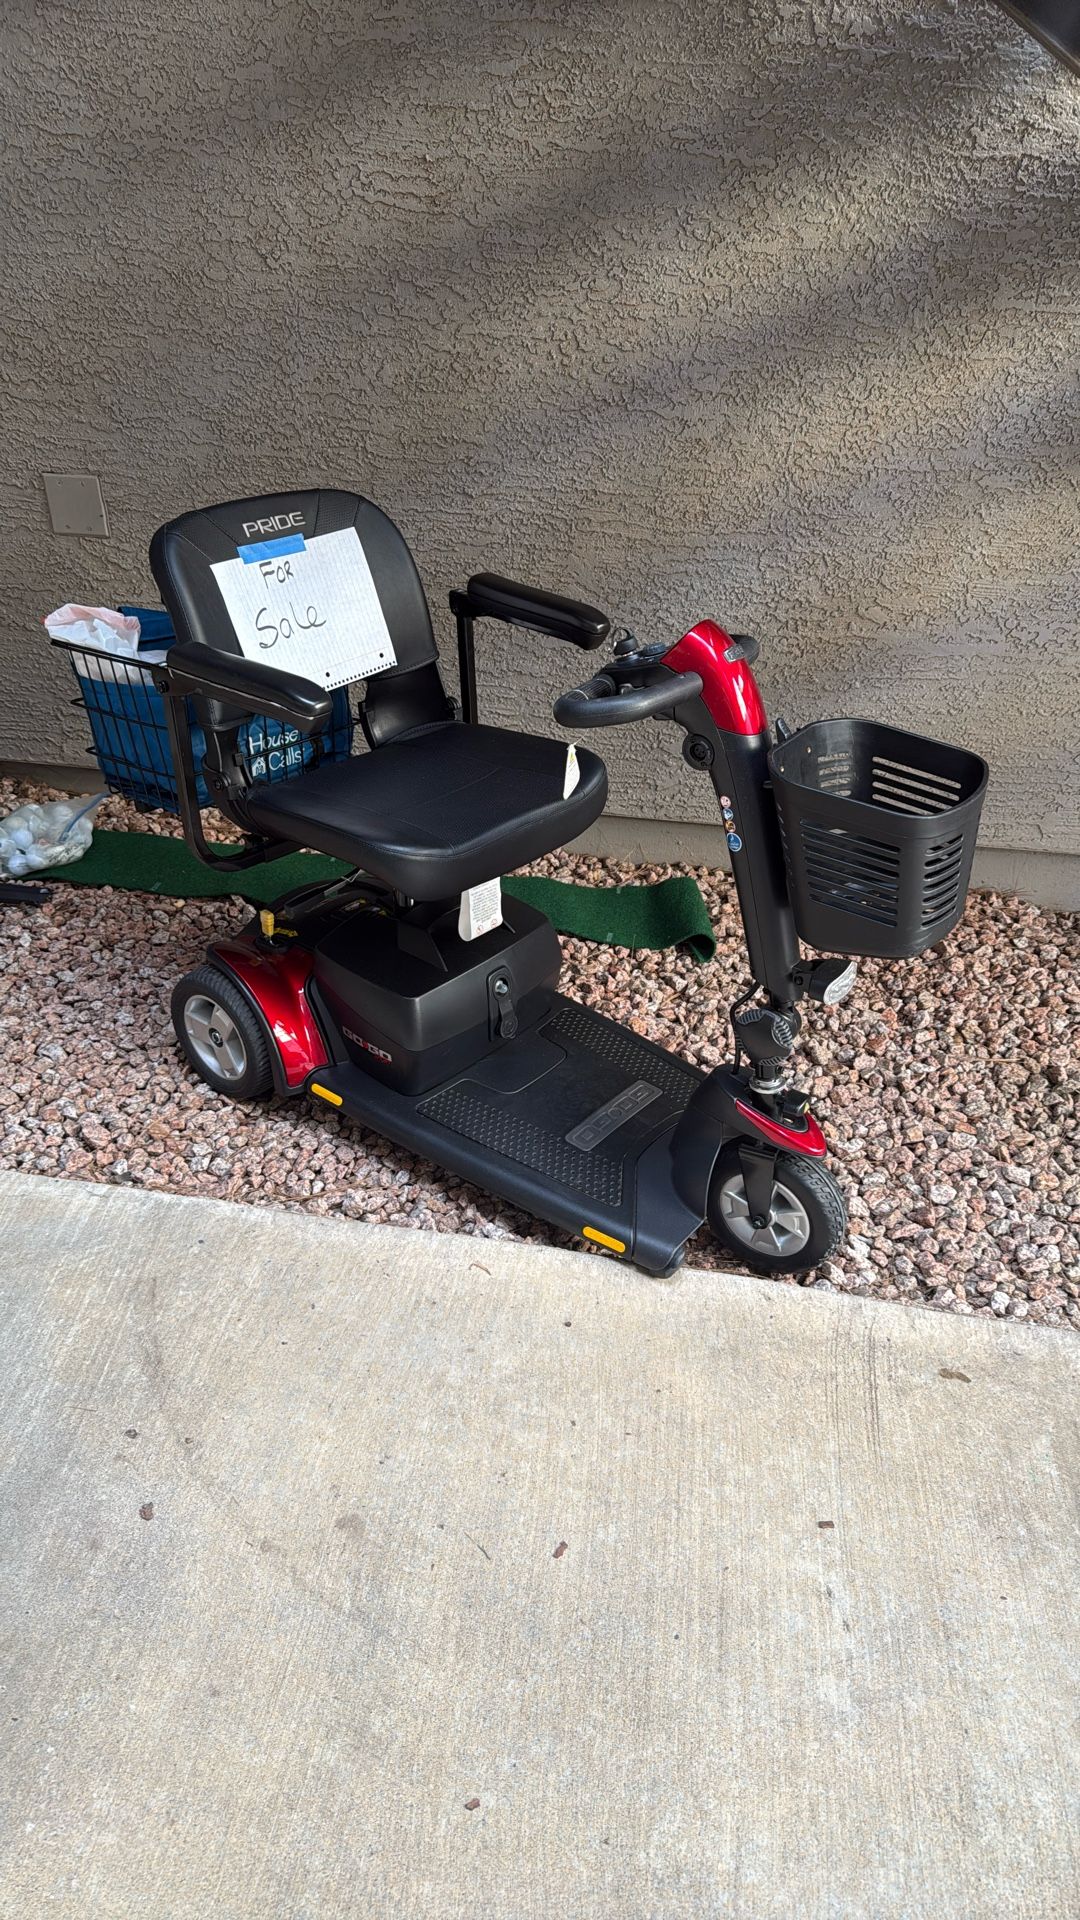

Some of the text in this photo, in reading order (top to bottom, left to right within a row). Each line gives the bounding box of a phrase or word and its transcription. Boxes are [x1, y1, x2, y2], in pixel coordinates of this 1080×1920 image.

[242, 511, 306, 538] PRIDE
[255, 601, 327, 649] Sale
[248, 729, 299, 755] House
[267, 747, 302, 771] Calls
